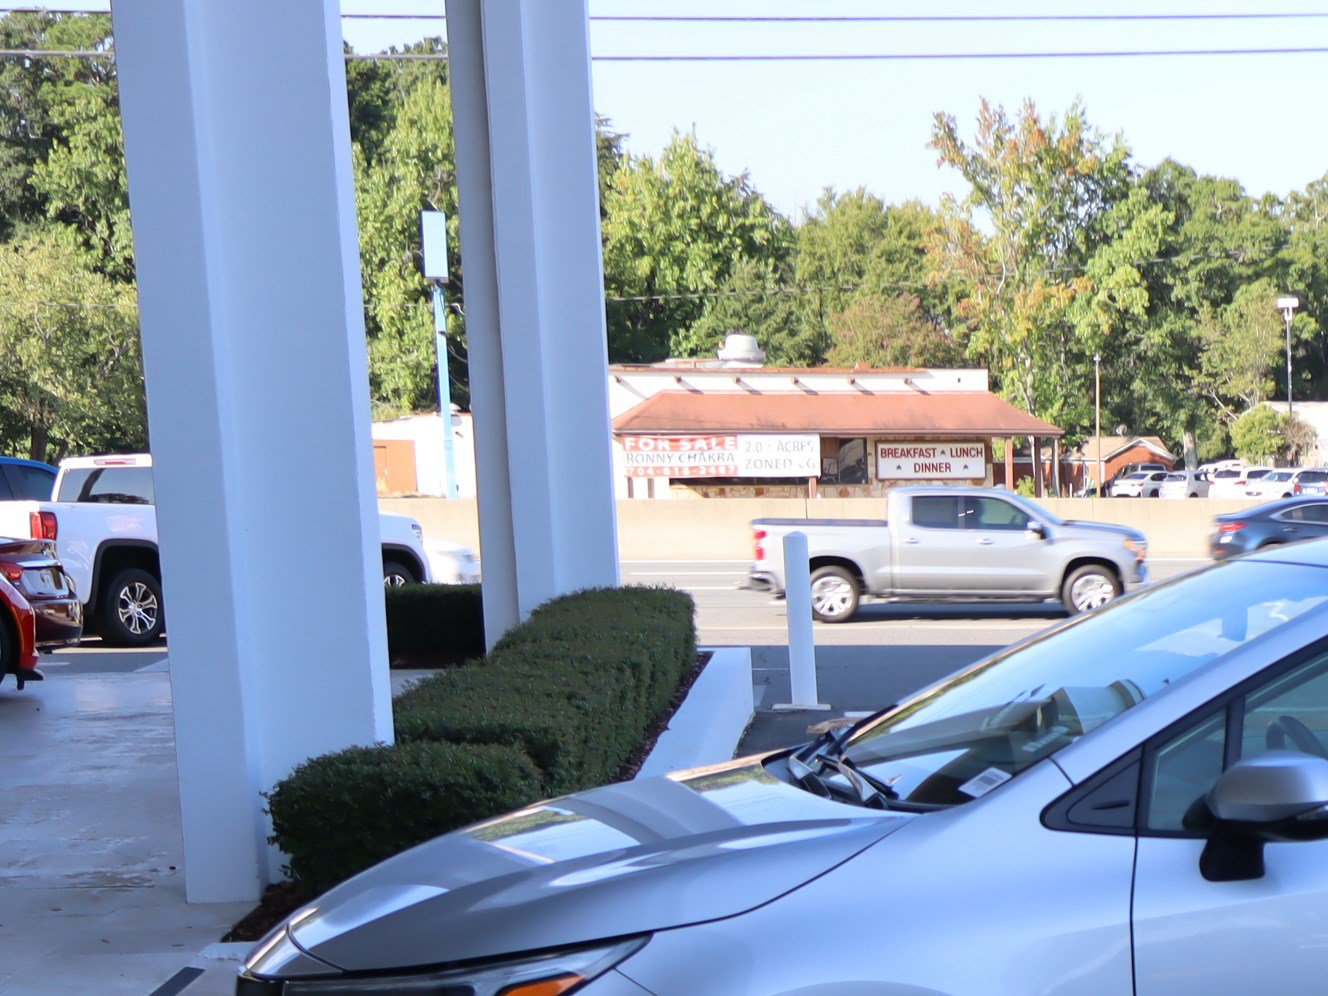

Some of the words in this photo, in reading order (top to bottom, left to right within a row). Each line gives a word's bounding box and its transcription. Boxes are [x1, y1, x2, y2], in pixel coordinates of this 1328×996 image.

[625, 437, 671, 451] FOR
[679, 436, 736, 450] SALE
[626, 452, 674, 465] RONNY
[678, 452, 735, 464] CHAKRA
[880, 447, 937, 458] BREAKFAST
[949, 447, 983, 458] LUNCH
[744, 458, 793, 470] ZONED
[913, 462, 952, 473] DINNER
